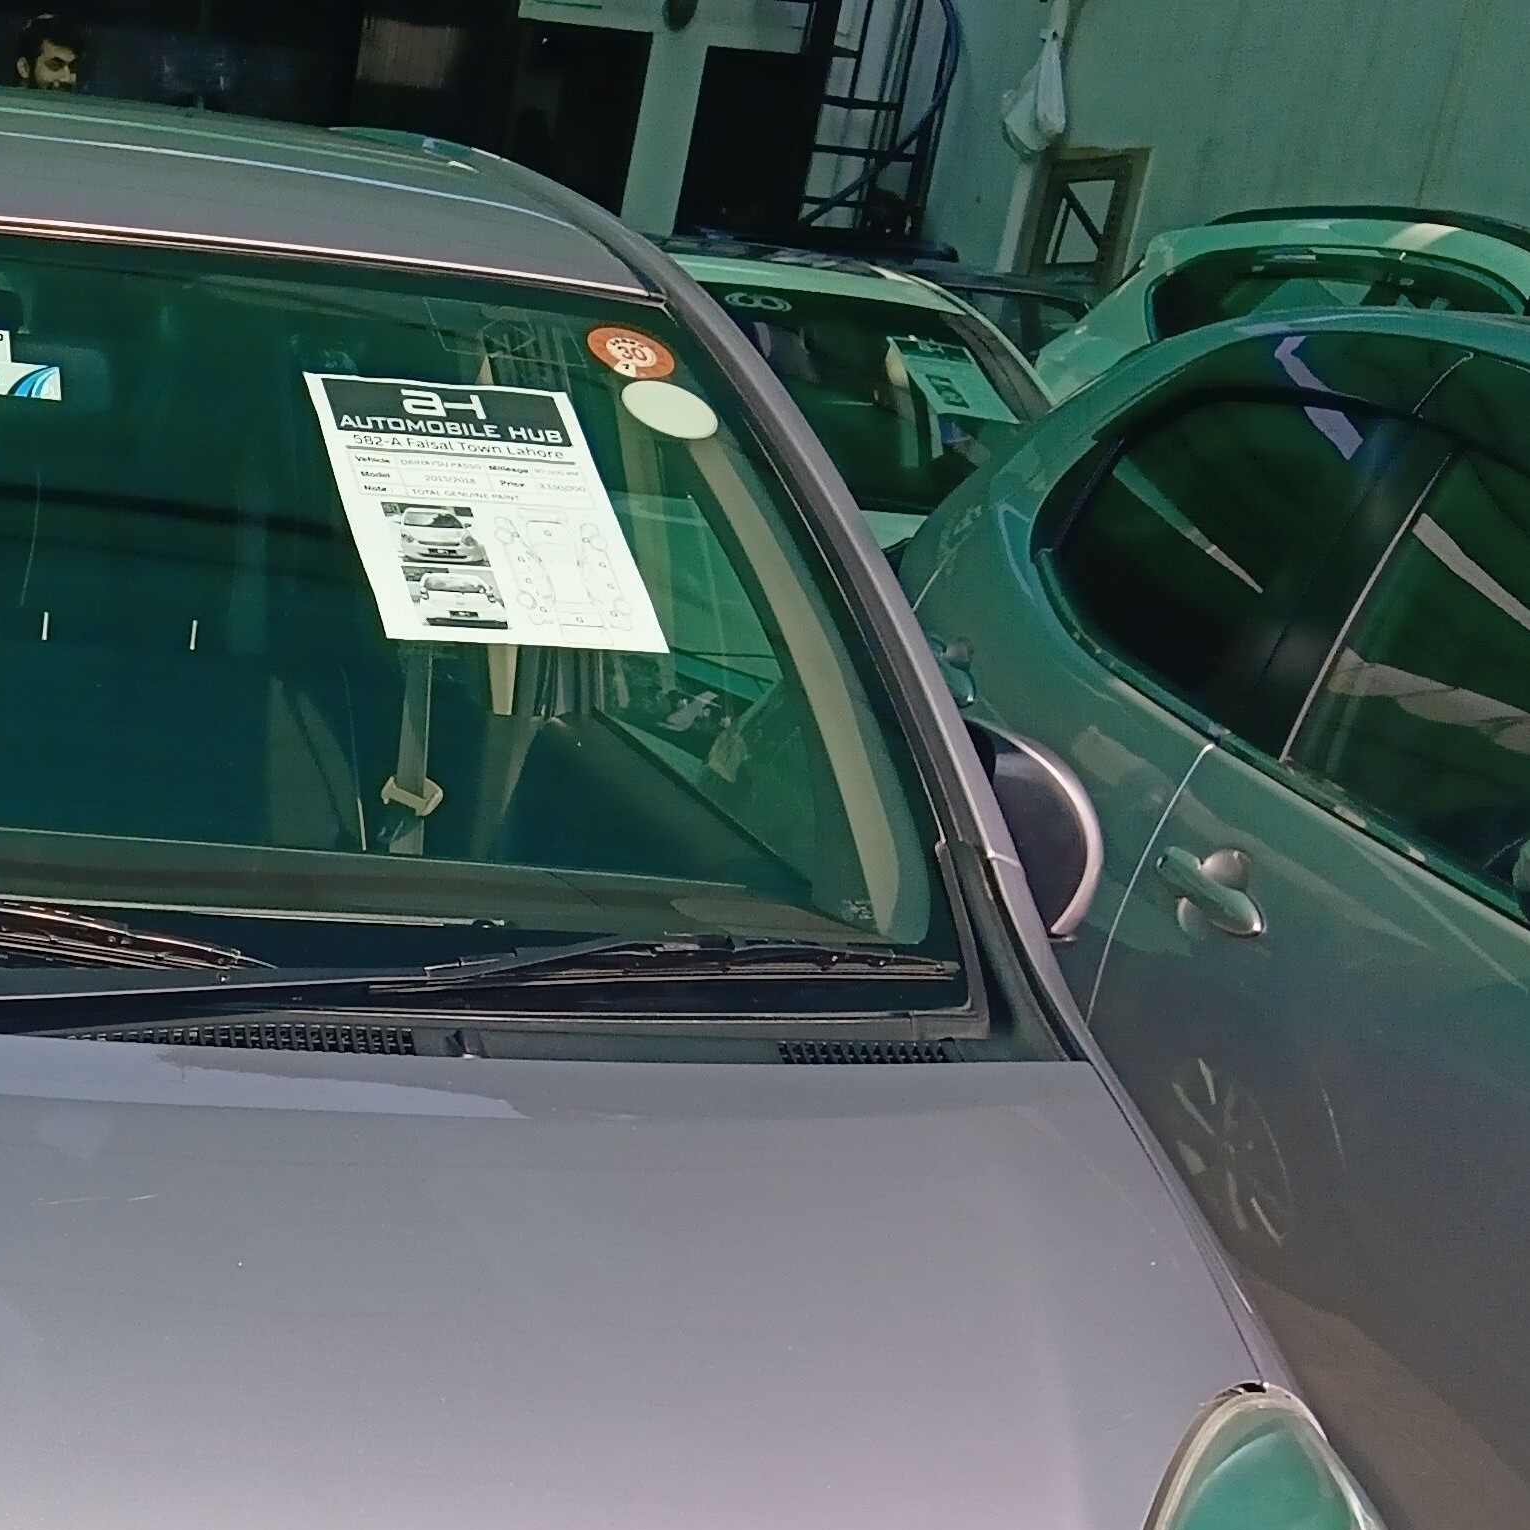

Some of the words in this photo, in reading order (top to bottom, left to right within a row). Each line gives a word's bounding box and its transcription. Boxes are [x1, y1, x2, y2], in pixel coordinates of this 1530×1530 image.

[339, 414, 501, 438] AUTOMOBILE
[509, 426, 564, 444] HUB
[352, 433, 402, 447] 582-A
[406, 436, 454, 452] Faisal
[457, 440, 504, 455] Town
[507, 445, 564, 459] Lahore
[354, 453, 391, 464] Vehicle
[360, 470, 391, 479] Model
[499, 479, 525, 488] Price
